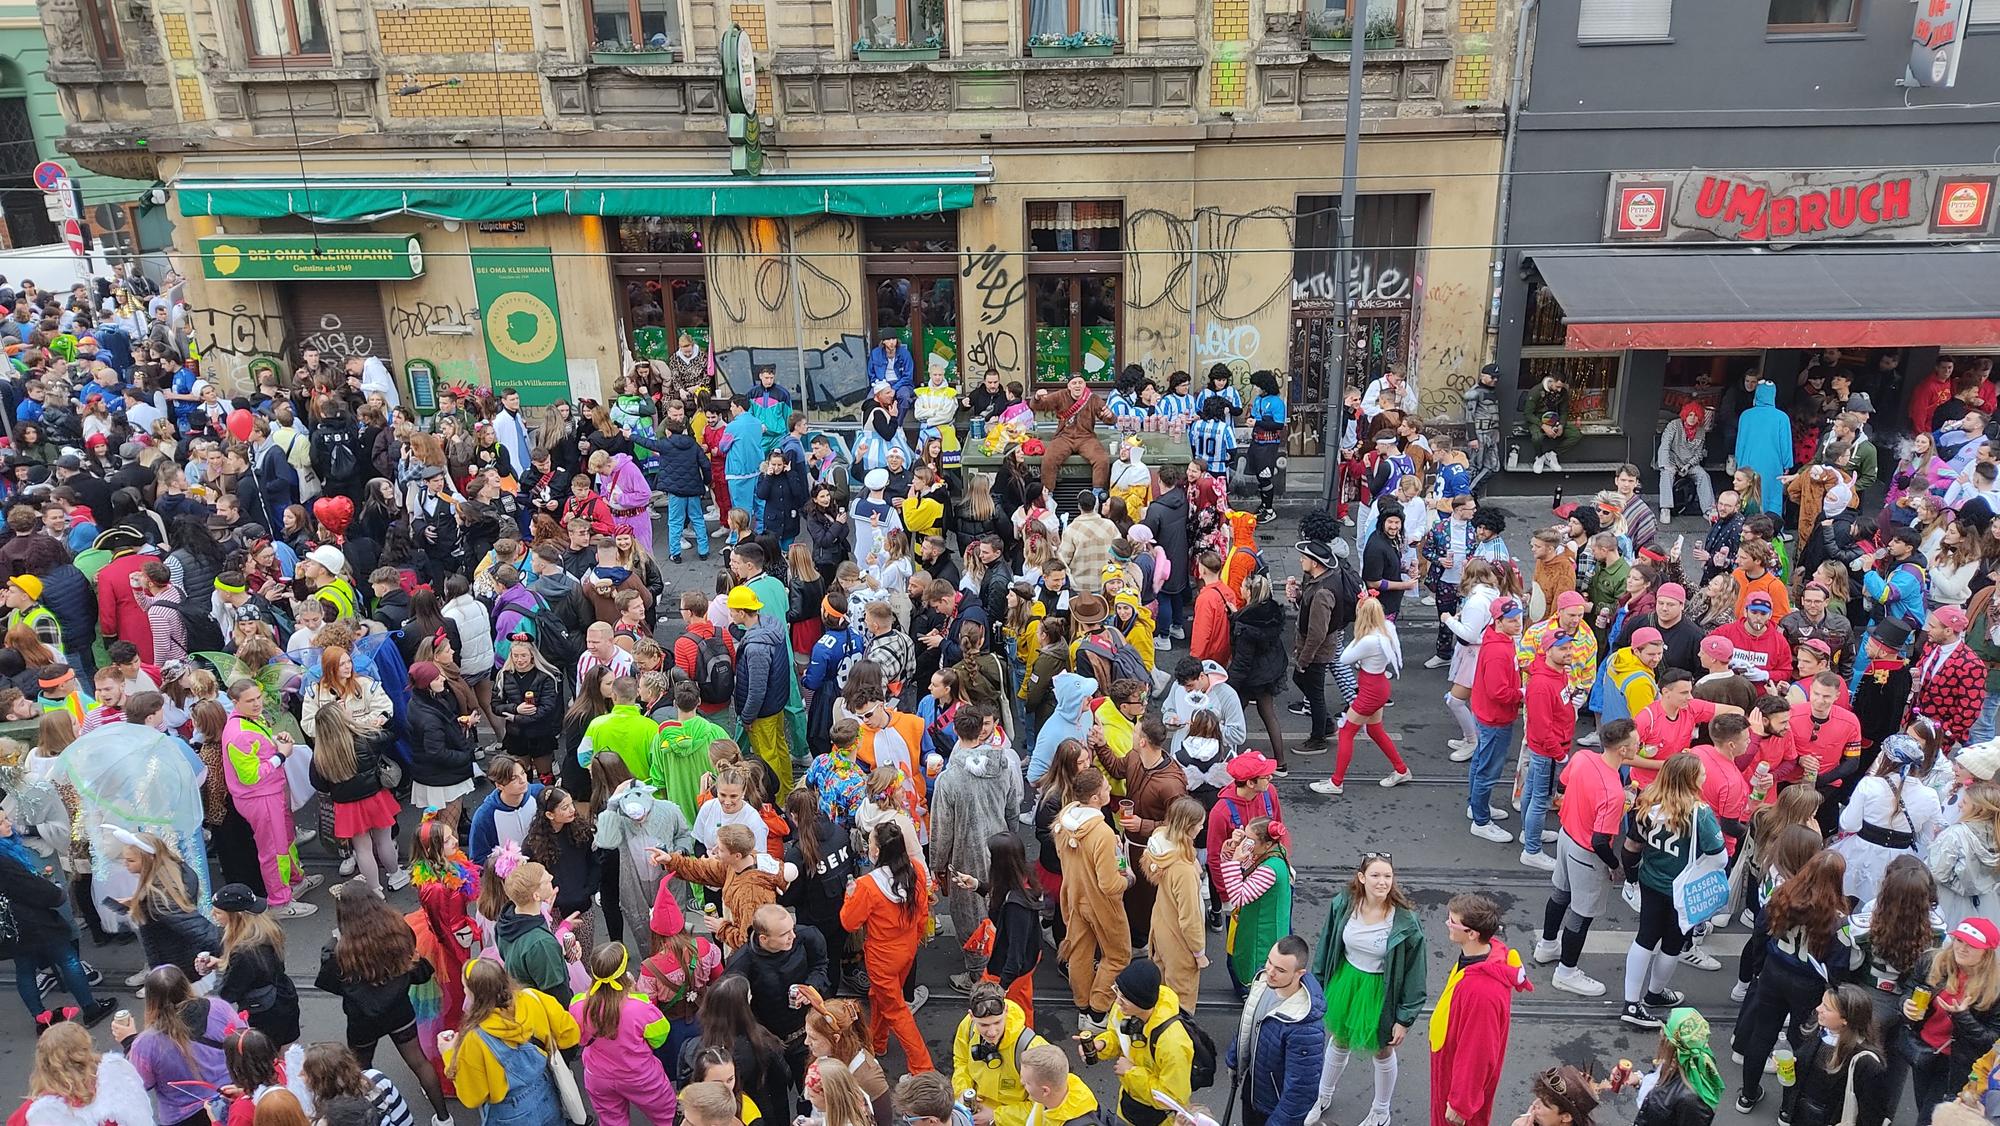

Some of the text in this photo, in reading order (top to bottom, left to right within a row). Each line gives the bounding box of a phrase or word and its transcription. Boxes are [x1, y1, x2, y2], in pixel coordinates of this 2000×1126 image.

[1630, 205, 1655, 214] PETERS
[1695, 175, 1912, 242] UMBRUCH
[249, 248, 394, 261] BEI OMA KLEINMANN
[336, 263, 352, 273] 1949
[495, 379, 567, 387] Herzlich Willkommen
[1197, 437, 1216, 457] 10
[1451, 464, 1464, 475] 13
[816, 845, 849, 875] SEK
[1685, 874, 1718, 896] LASSEN
[1687, 883, 1727, 905] SIE MICH
[1690, 896, 1721, 915] DURCH.
